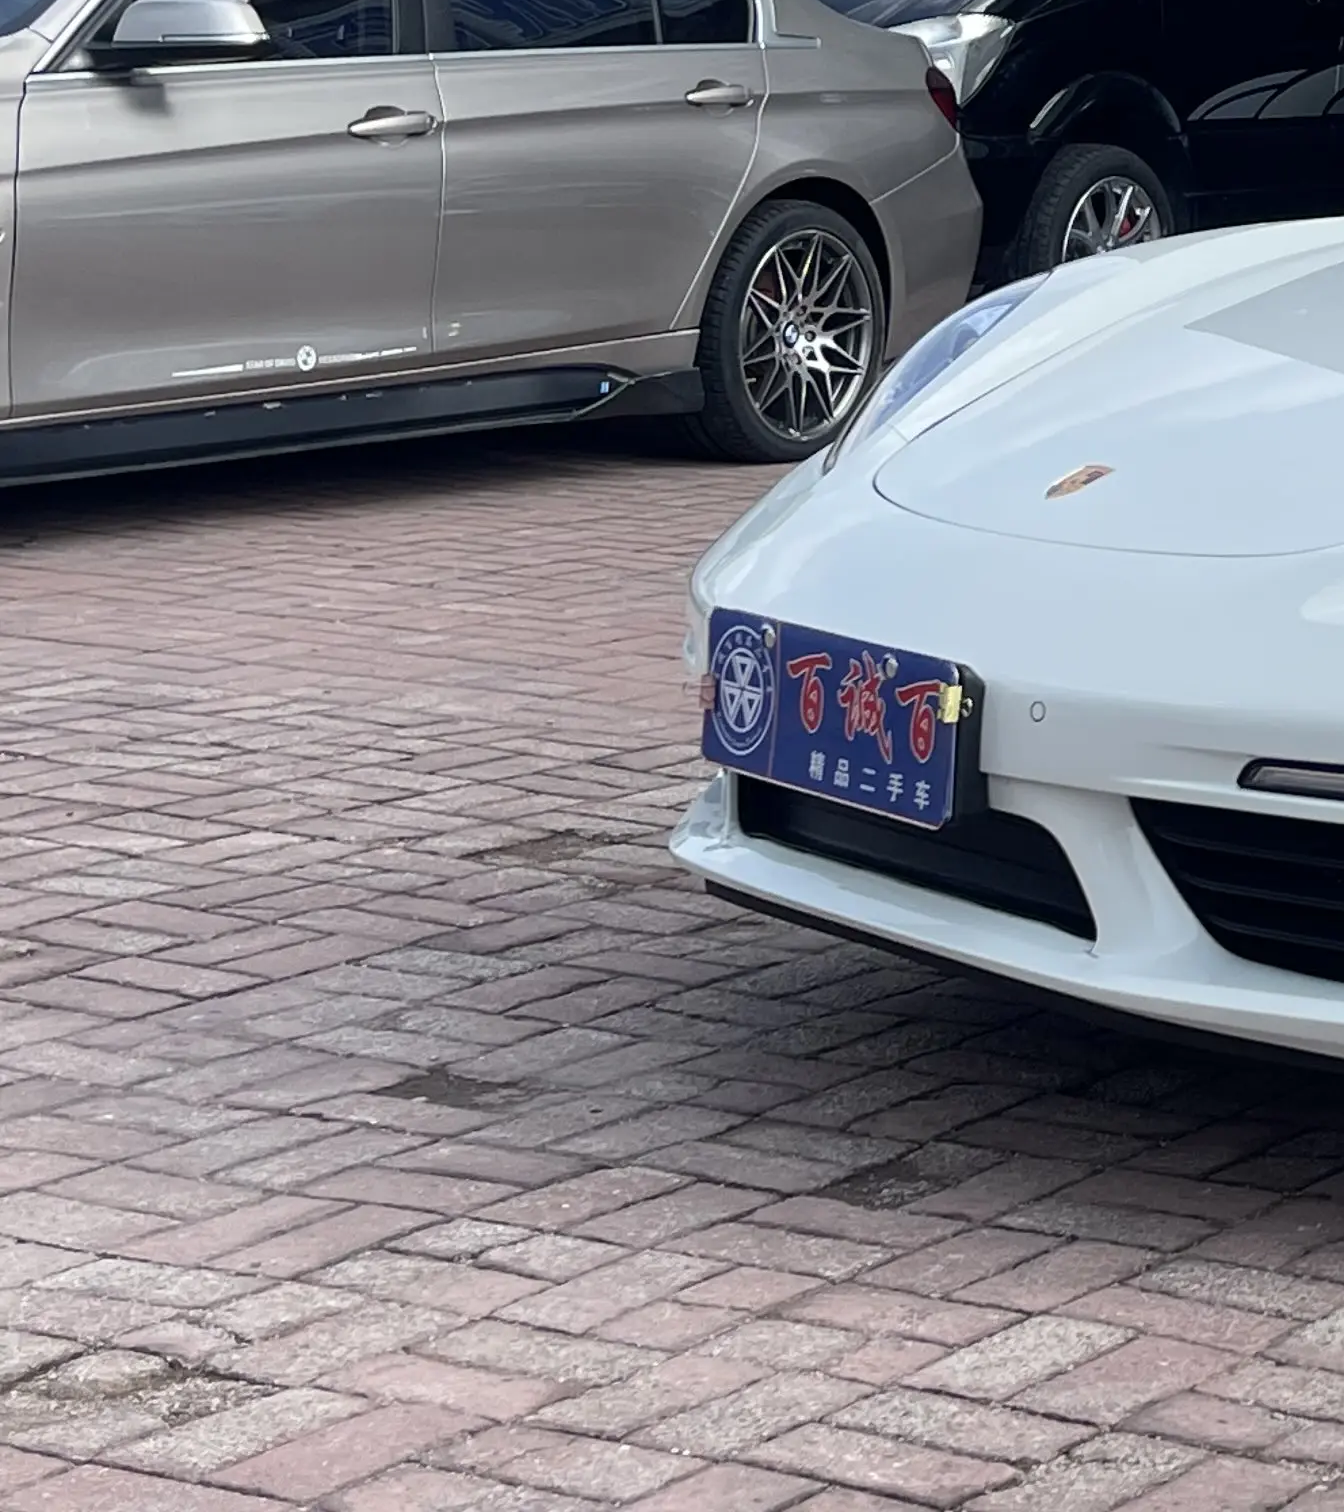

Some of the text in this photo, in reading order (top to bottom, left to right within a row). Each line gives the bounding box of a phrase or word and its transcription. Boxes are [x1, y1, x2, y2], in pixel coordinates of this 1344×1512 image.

[808, 749, 931, 811] 精品二手车
